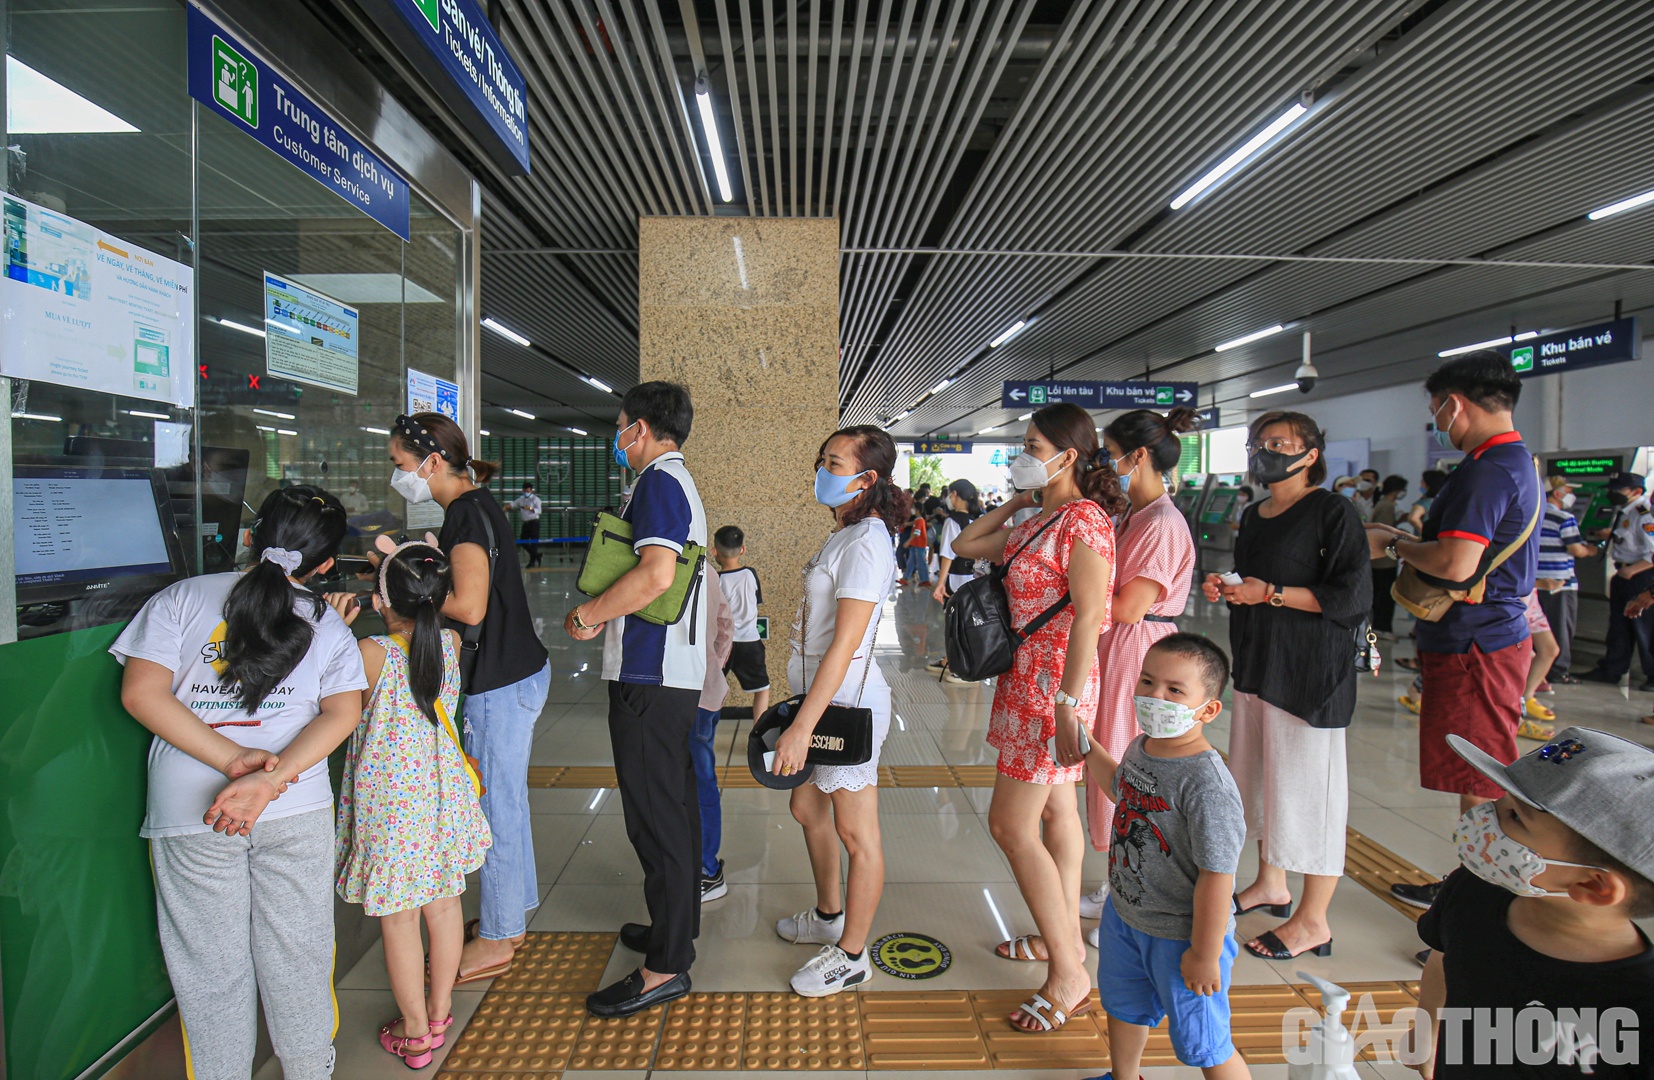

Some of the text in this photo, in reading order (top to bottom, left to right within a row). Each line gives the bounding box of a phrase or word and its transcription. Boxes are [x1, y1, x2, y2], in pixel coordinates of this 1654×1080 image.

[442, 19, 478, 84] Tickets
[482, 75, 524, 146] Information
[273, 83, 394, 200] Trung tâm dịch vụ
[273, 125, 371, 205] Customer Service
[1541, 330, 1612, 356] Khu bán vé
[1541, 356, 1566, 367] Tickets
[1061, 387, 1077, 395] lên
[1079, 387, 1093, 395] tàu
[1106, 386, 1155, 396] Khu bán vé
[956, 444, 962, 452] B
